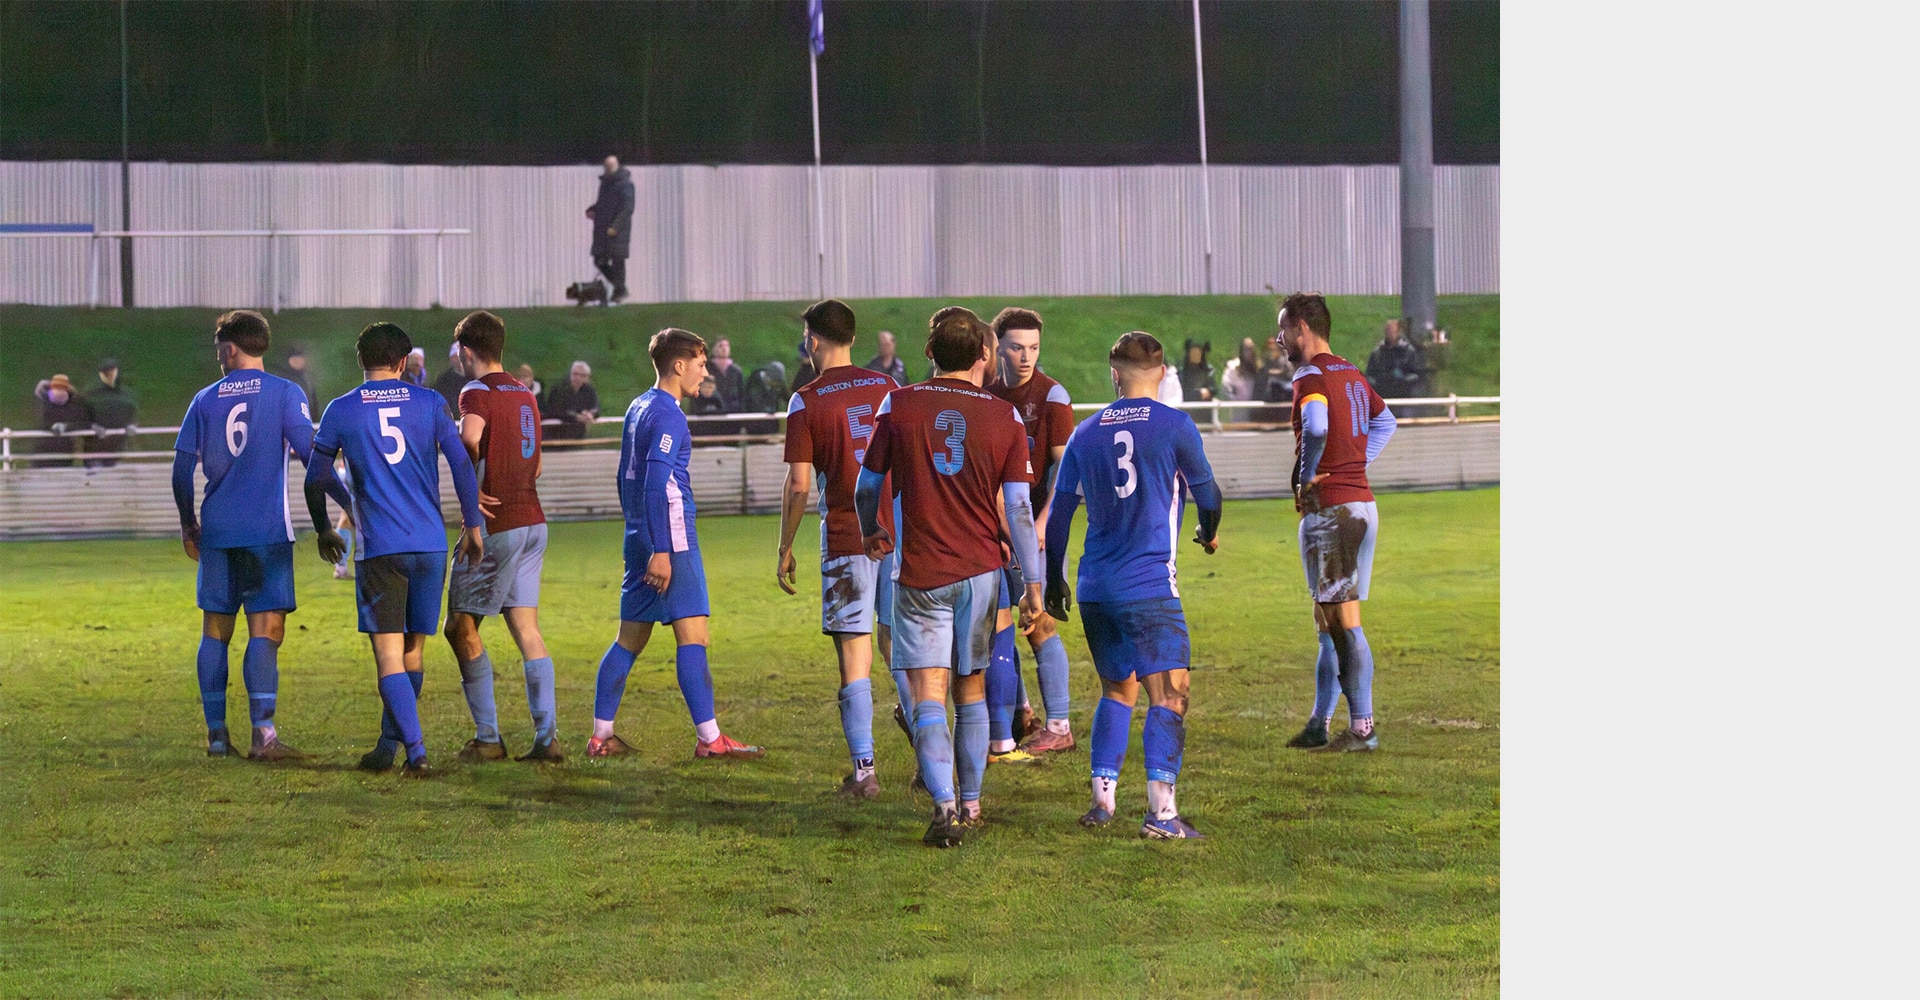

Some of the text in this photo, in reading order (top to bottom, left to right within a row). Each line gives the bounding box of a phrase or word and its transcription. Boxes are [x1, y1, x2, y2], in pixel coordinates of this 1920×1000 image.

[219, 378, 261, 391] Bowers
[360, 387, 409, 396] Bowers
[816, 381, 852, 396] SKELTON
[1102, 406, 1151, 418] Bowers
[1345, 381, 1370, 437] 10
[226, 402, 248, 457] 6
[378, 406, 406, 465] 5
[520, 405, 536, 459] 9
[846, 404, 873, 465] 5
[933, 409, 967, 476] 3
[1114, 430, 1138, 499] 3
